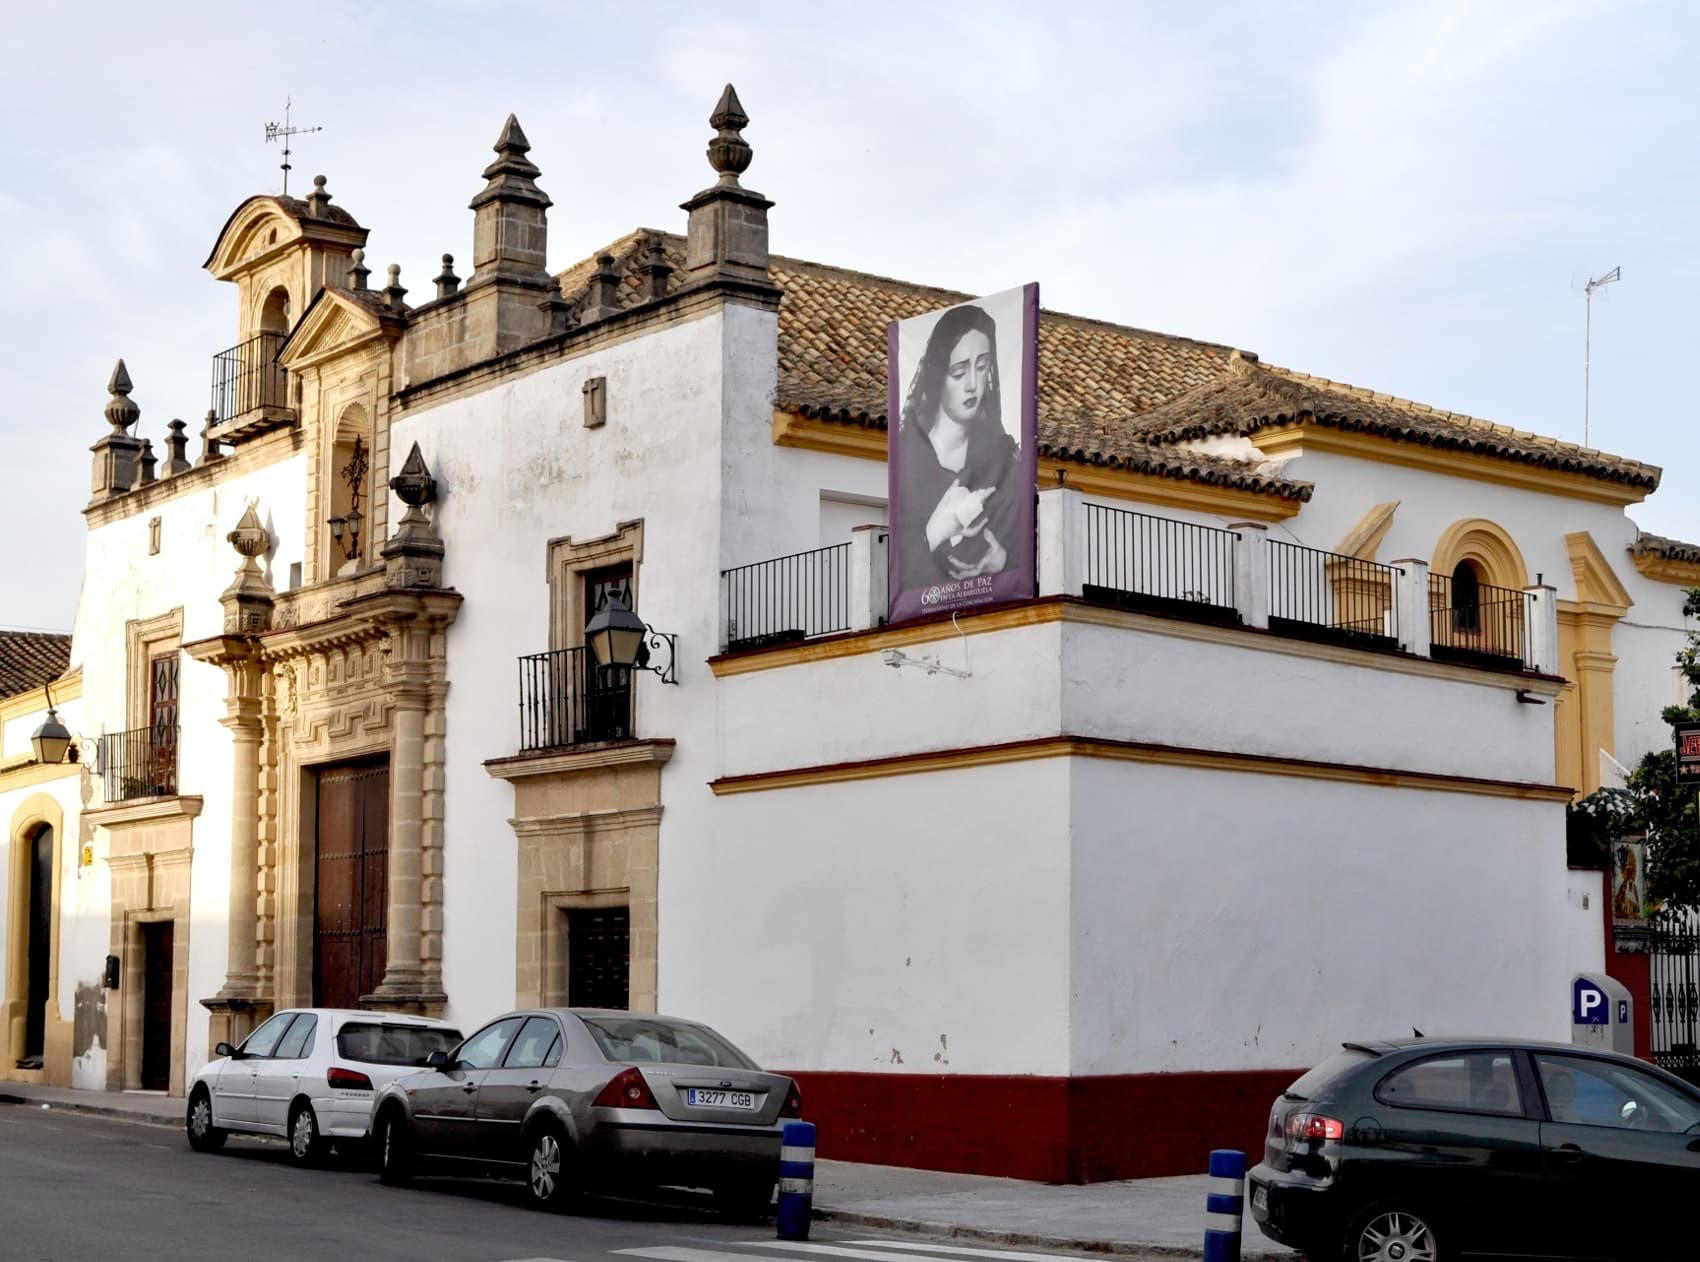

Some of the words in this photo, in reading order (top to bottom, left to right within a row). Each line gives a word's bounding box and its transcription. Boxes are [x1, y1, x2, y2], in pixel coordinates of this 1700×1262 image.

[941, 583, 961, 594] AÑOS
[964, 580, 974, 590] DE
[1581, 989, 1601, 1017] P
[1620, 1004, 1626, 1020] P
[698, 1091, 726, 1105] 3277
[731, 1093, 751, 1107] CGB
